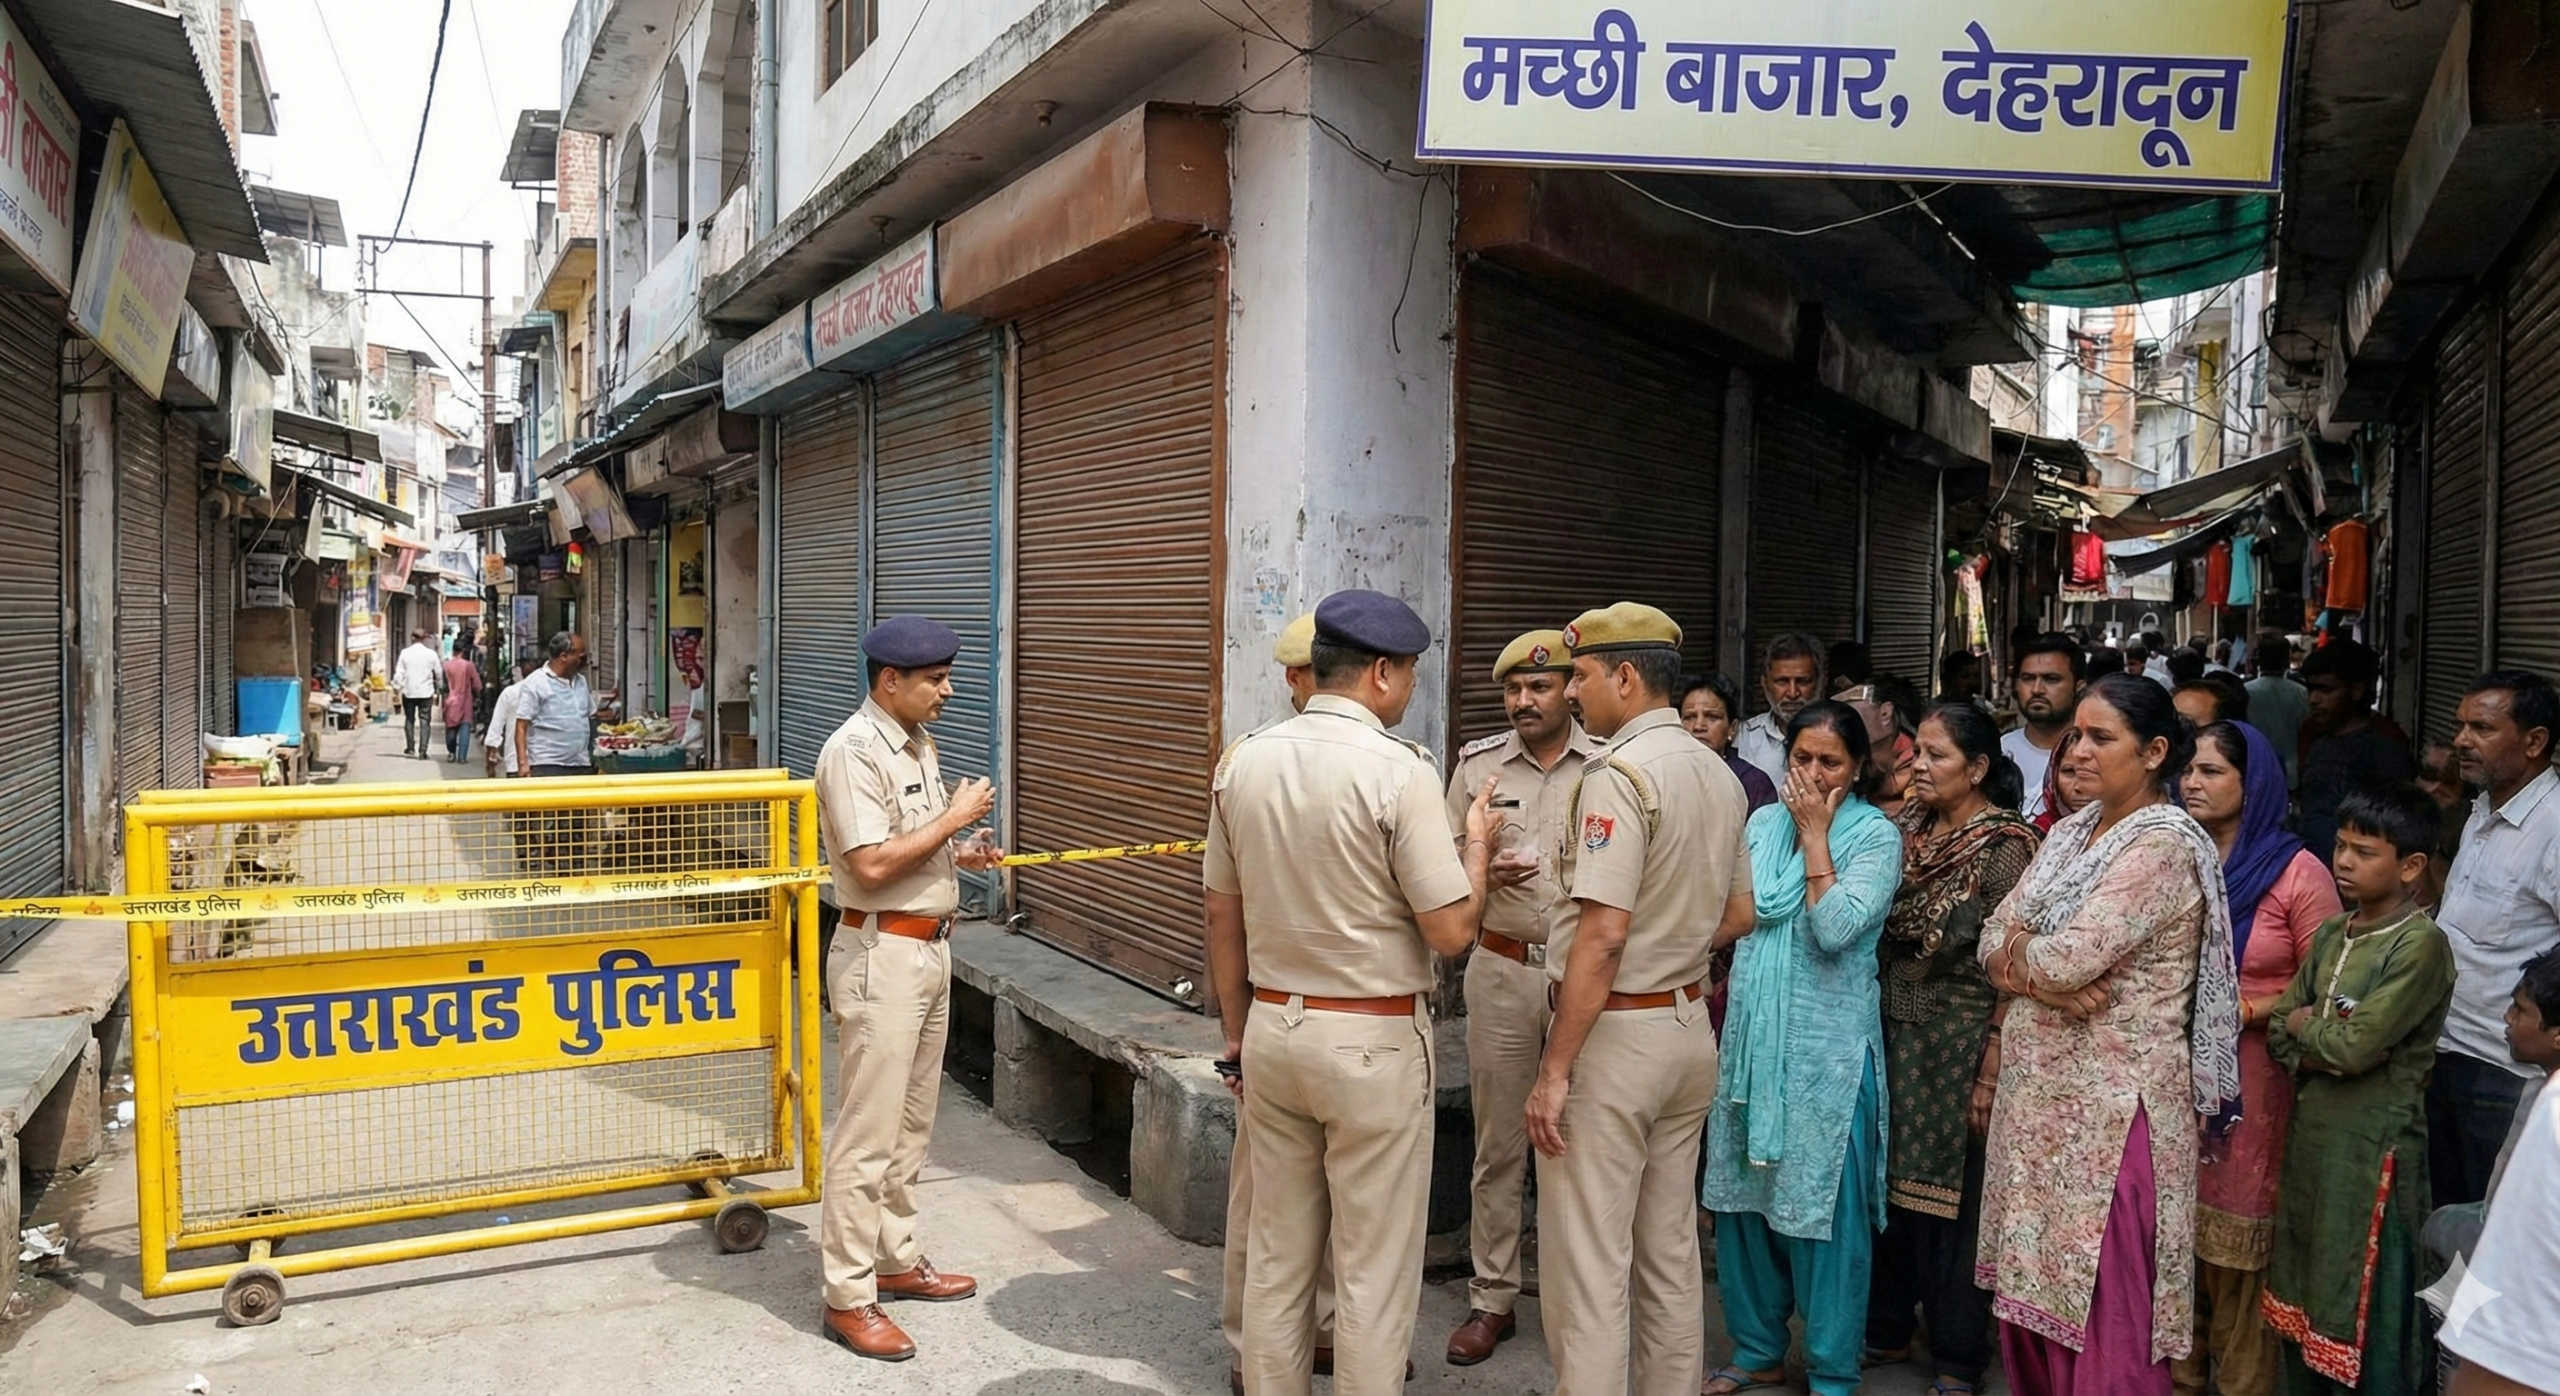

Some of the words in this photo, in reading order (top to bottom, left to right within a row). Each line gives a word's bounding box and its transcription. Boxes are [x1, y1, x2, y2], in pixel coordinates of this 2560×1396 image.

[1463, 9, 1645, 110] मच्छी
[1666, 43, 1908, 128] बाजार,
[1942, 20, 2249, 167] देहरादून
[22, 100, 71, 228] बाजार
[121, 897, 191, 915] उत्तराखंड
[196, 894, 242, 916] पुलिस
[292, 890, 357, 908] उत्तराखंड
[362, 888, 405, 909] पुलिस
[456, 884, 517, 901] उत्तराखंड
[522, 881, 561, 901] पुलिस
[231, 960, 524, 1063] उत्तराखंड
[547, 950, 741, 1055] पुलिस
